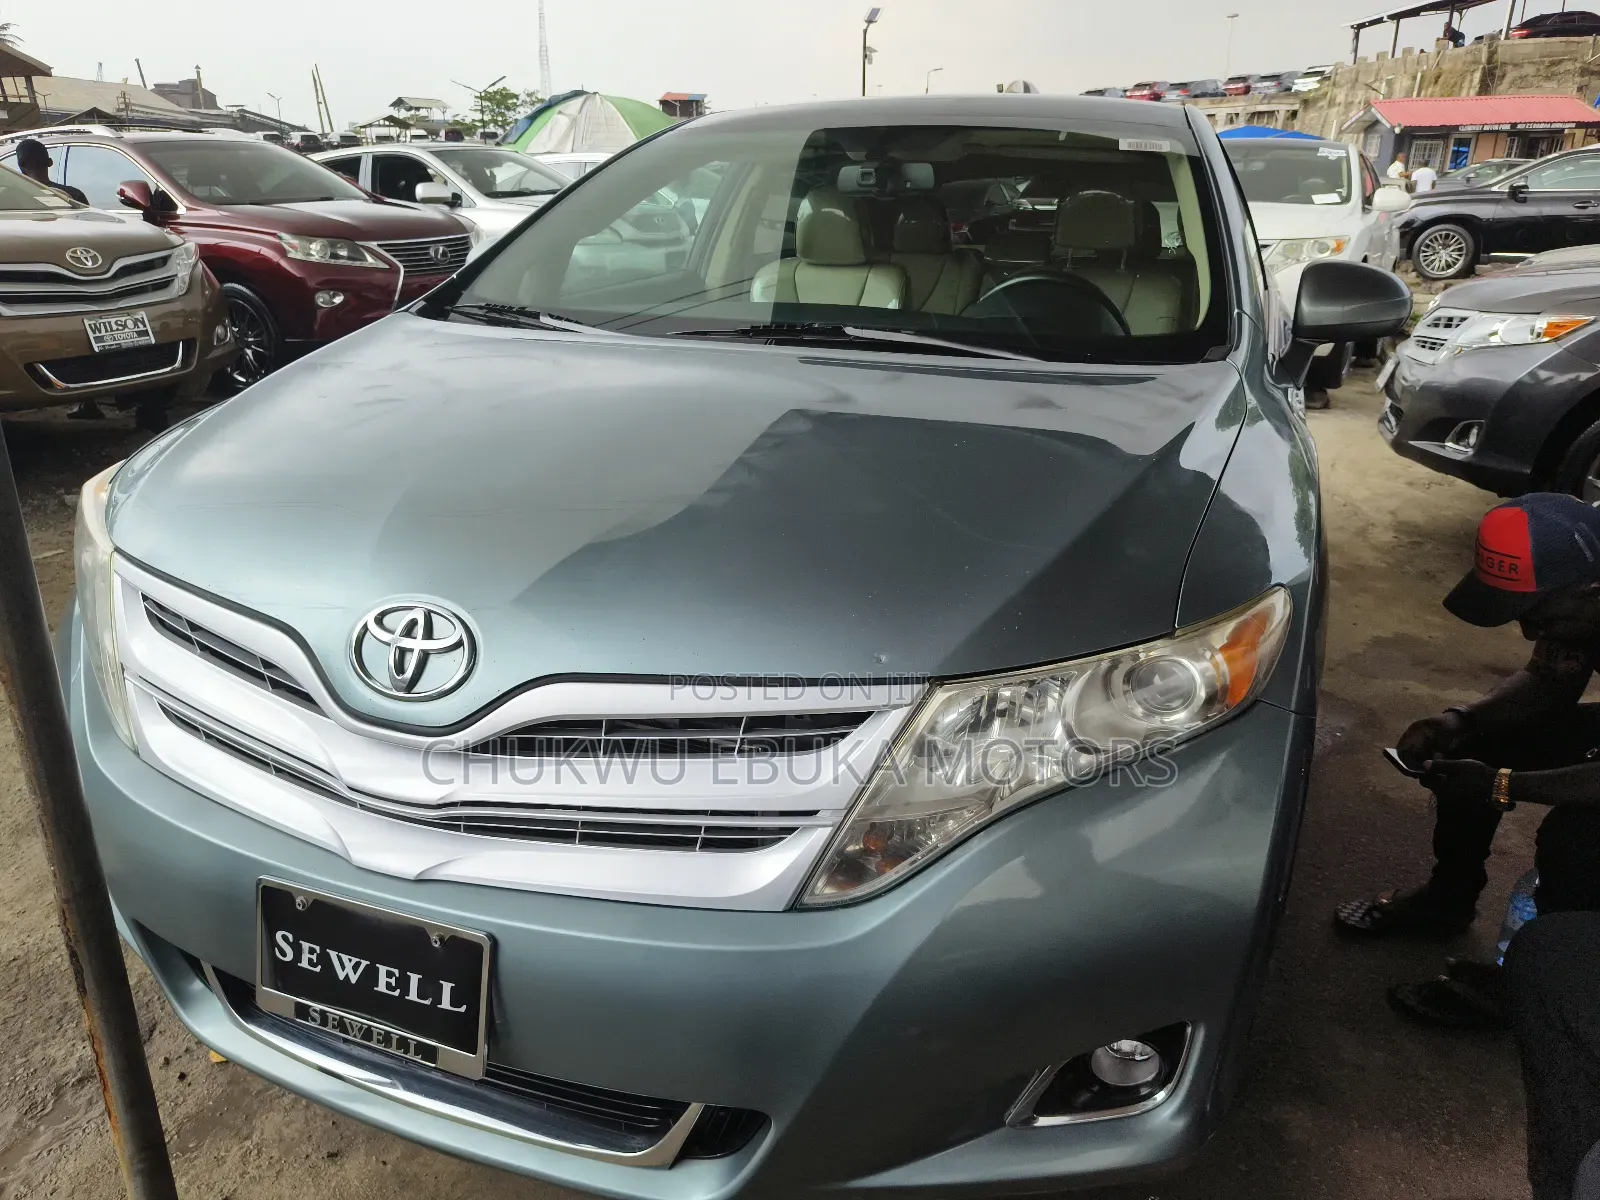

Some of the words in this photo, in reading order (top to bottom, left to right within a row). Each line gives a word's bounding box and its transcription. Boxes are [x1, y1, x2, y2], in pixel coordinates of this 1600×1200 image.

[88, 317, 146, 335] WILSON
[113, 332, 138, 341] TOYOTA
[274, 929, 467, 1013] SEWELL
[308, 1006, 422, 1060] SEWELL
